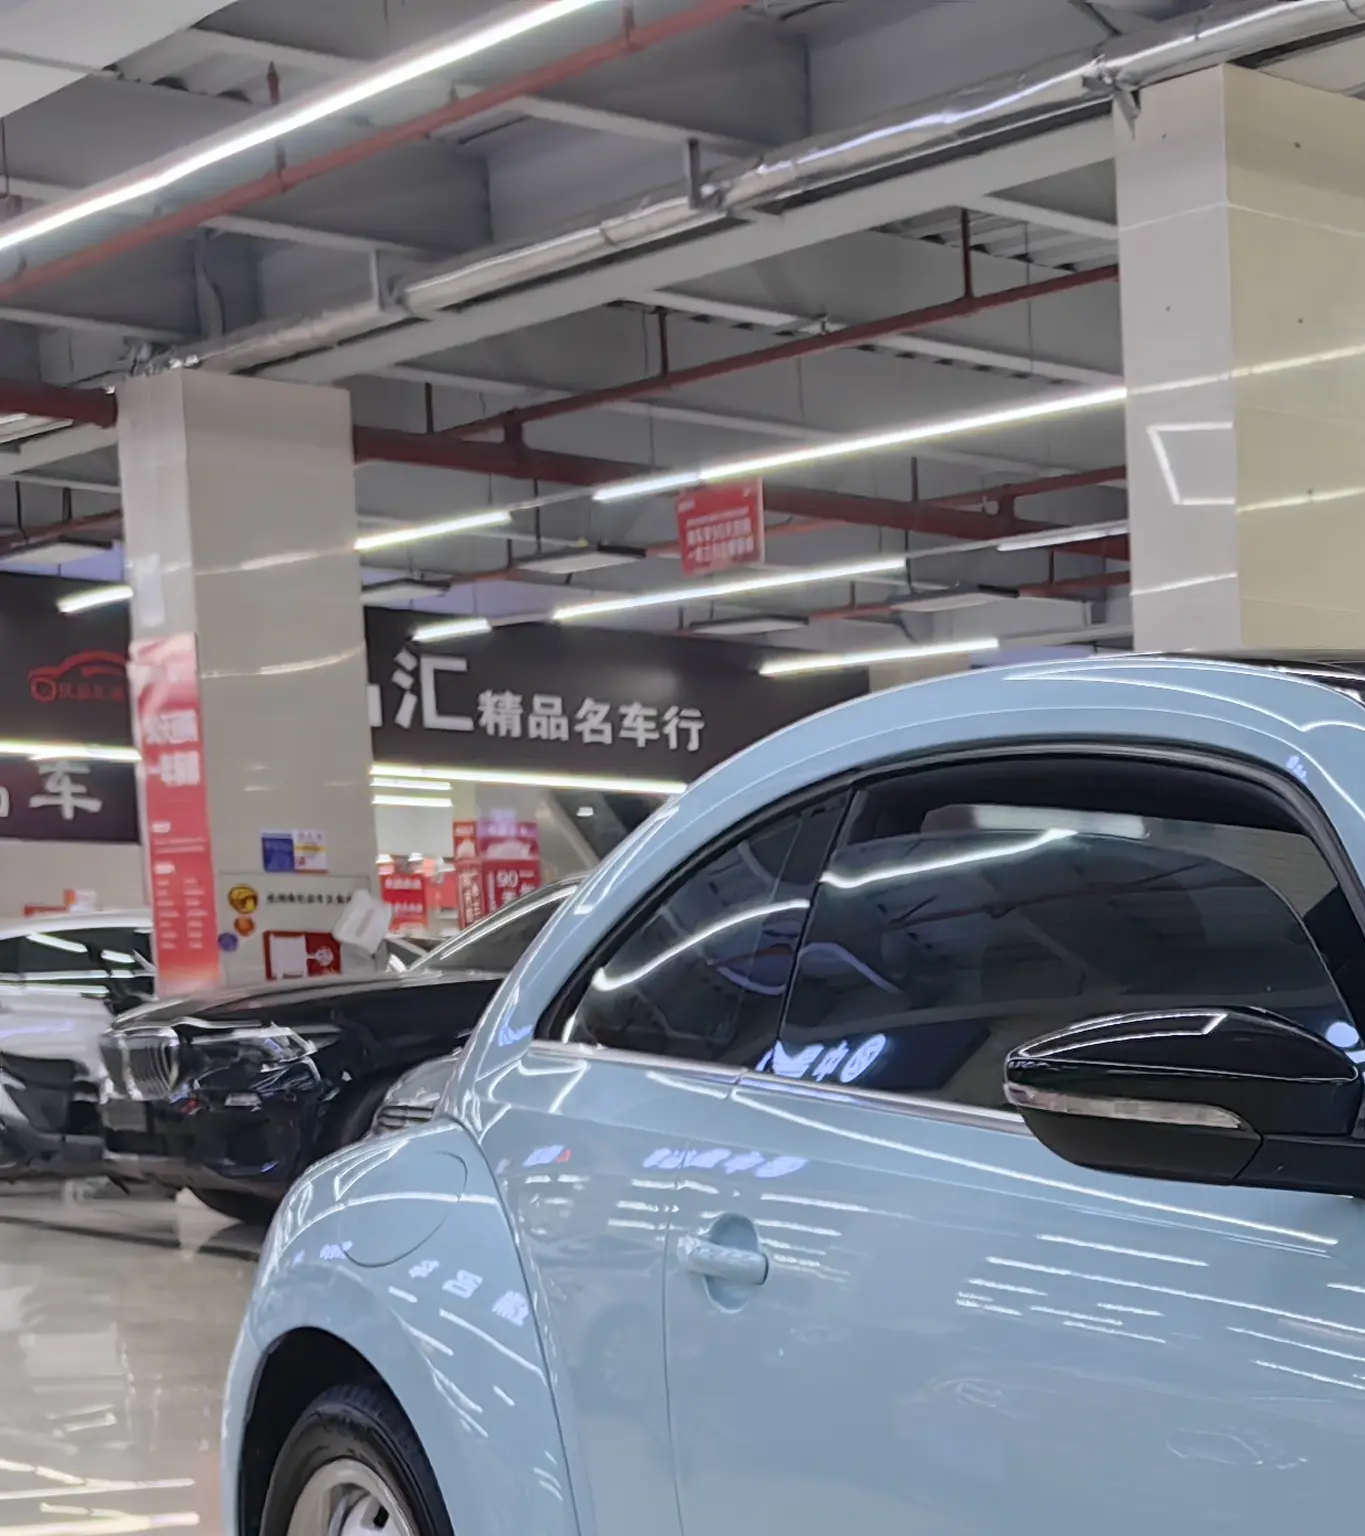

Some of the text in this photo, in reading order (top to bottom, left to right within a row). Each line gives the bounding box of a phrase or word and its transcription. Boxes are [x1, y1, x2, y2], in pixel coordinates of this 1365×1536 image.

[478, 688, 706, 752] 精品名车行
